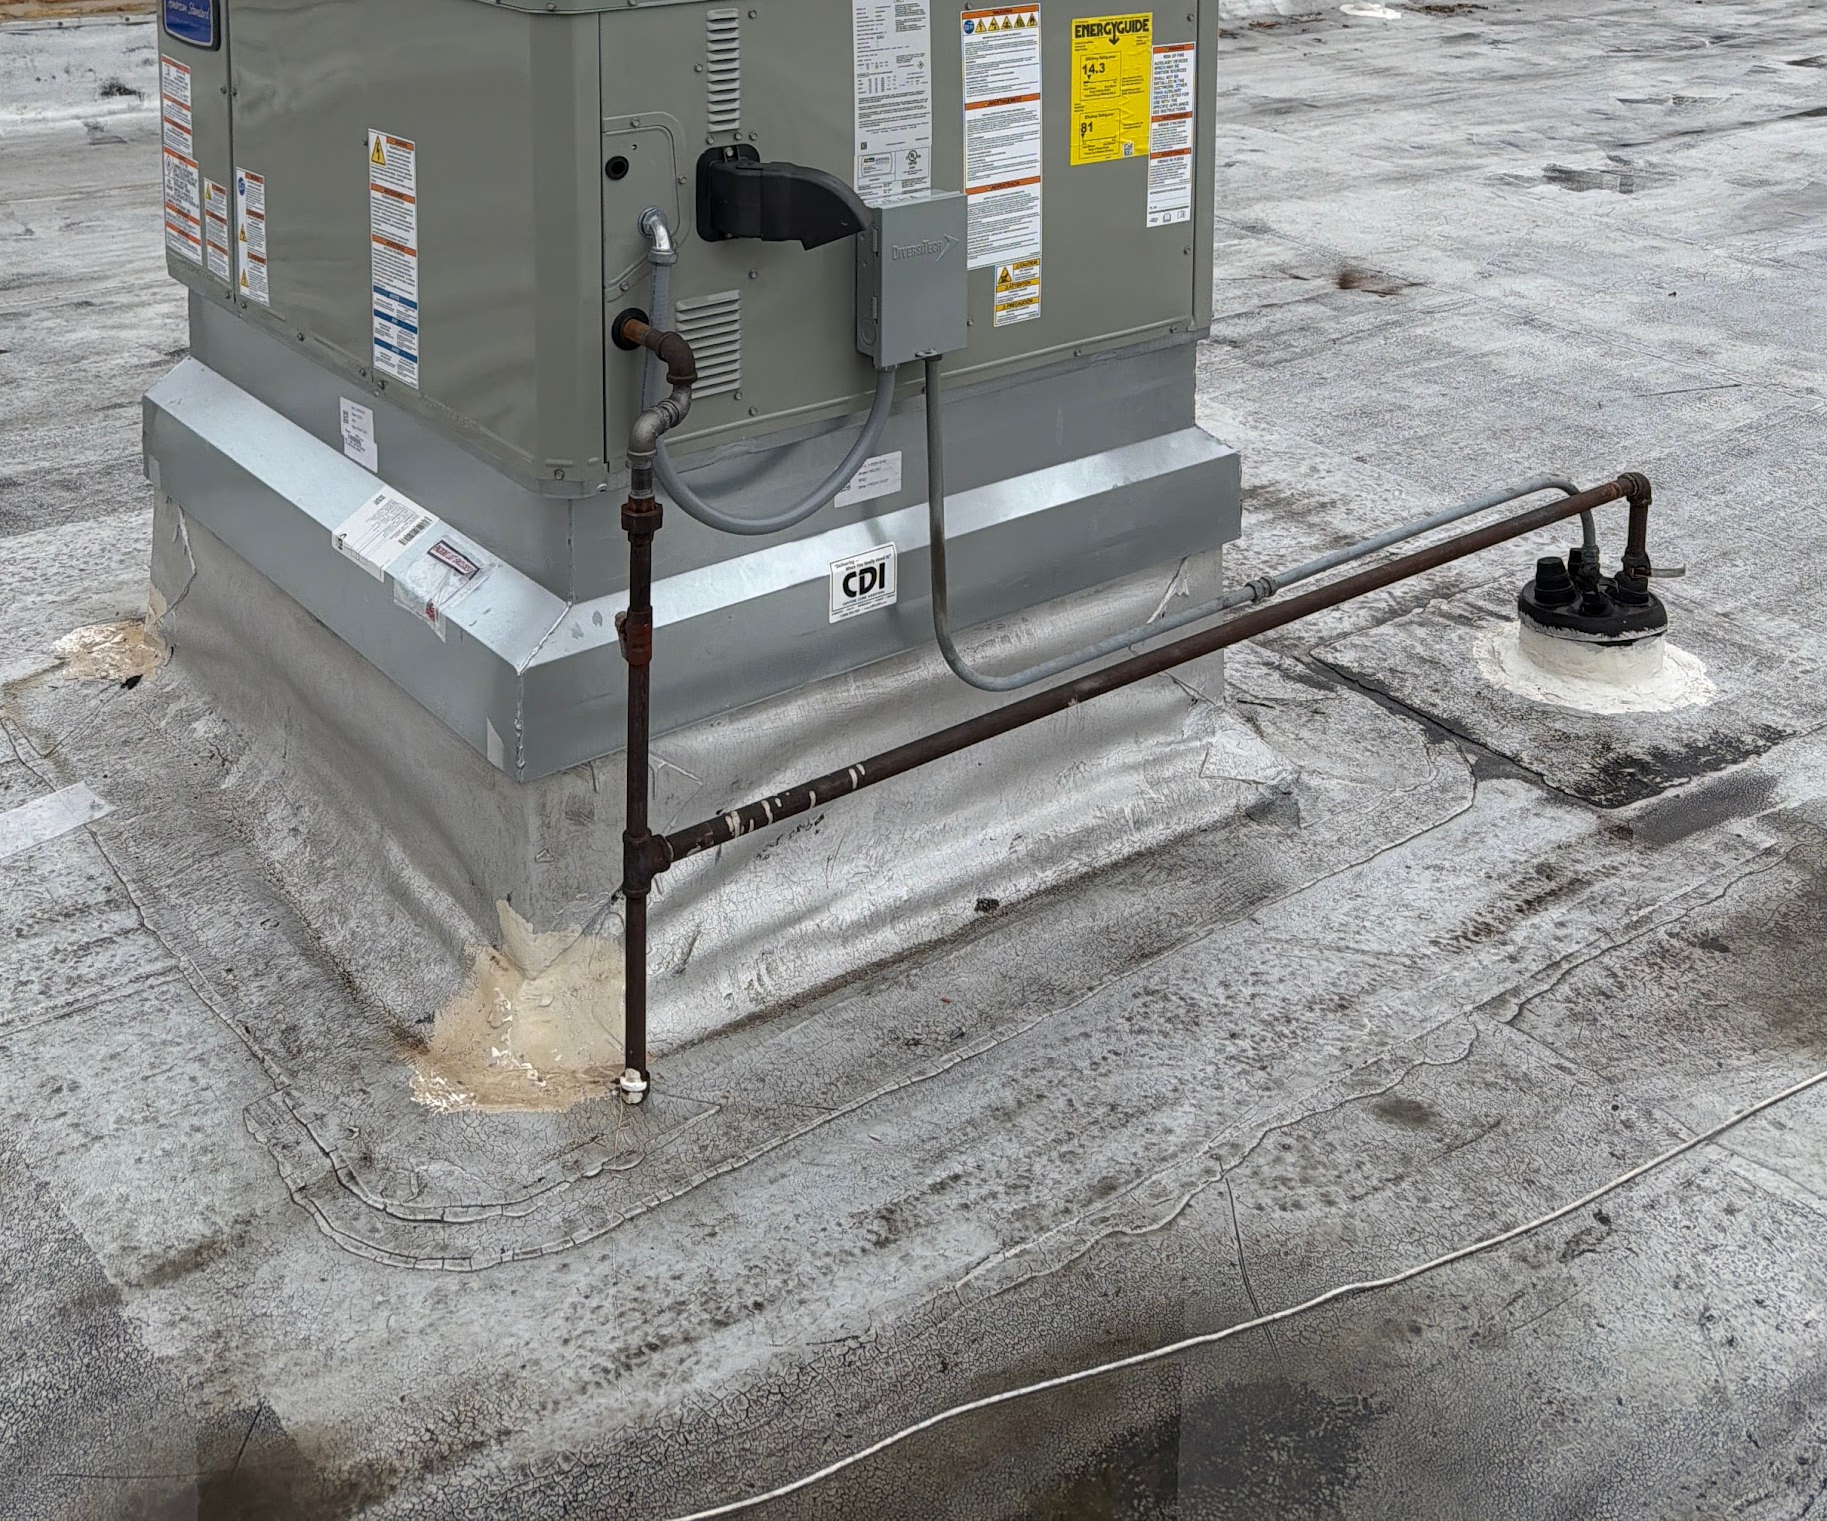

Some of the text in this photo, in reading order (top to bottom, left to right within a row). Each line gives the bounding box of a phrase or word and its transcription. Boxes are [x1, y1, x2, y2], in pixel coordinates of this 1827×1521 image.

[1074, 18, 1150, 39] ENERGYGUIDE
[1082, 62, 1106, 75] 14.3
[1080, 121, 1093, 133] 81
[842, 562, 886, 598] CDI
